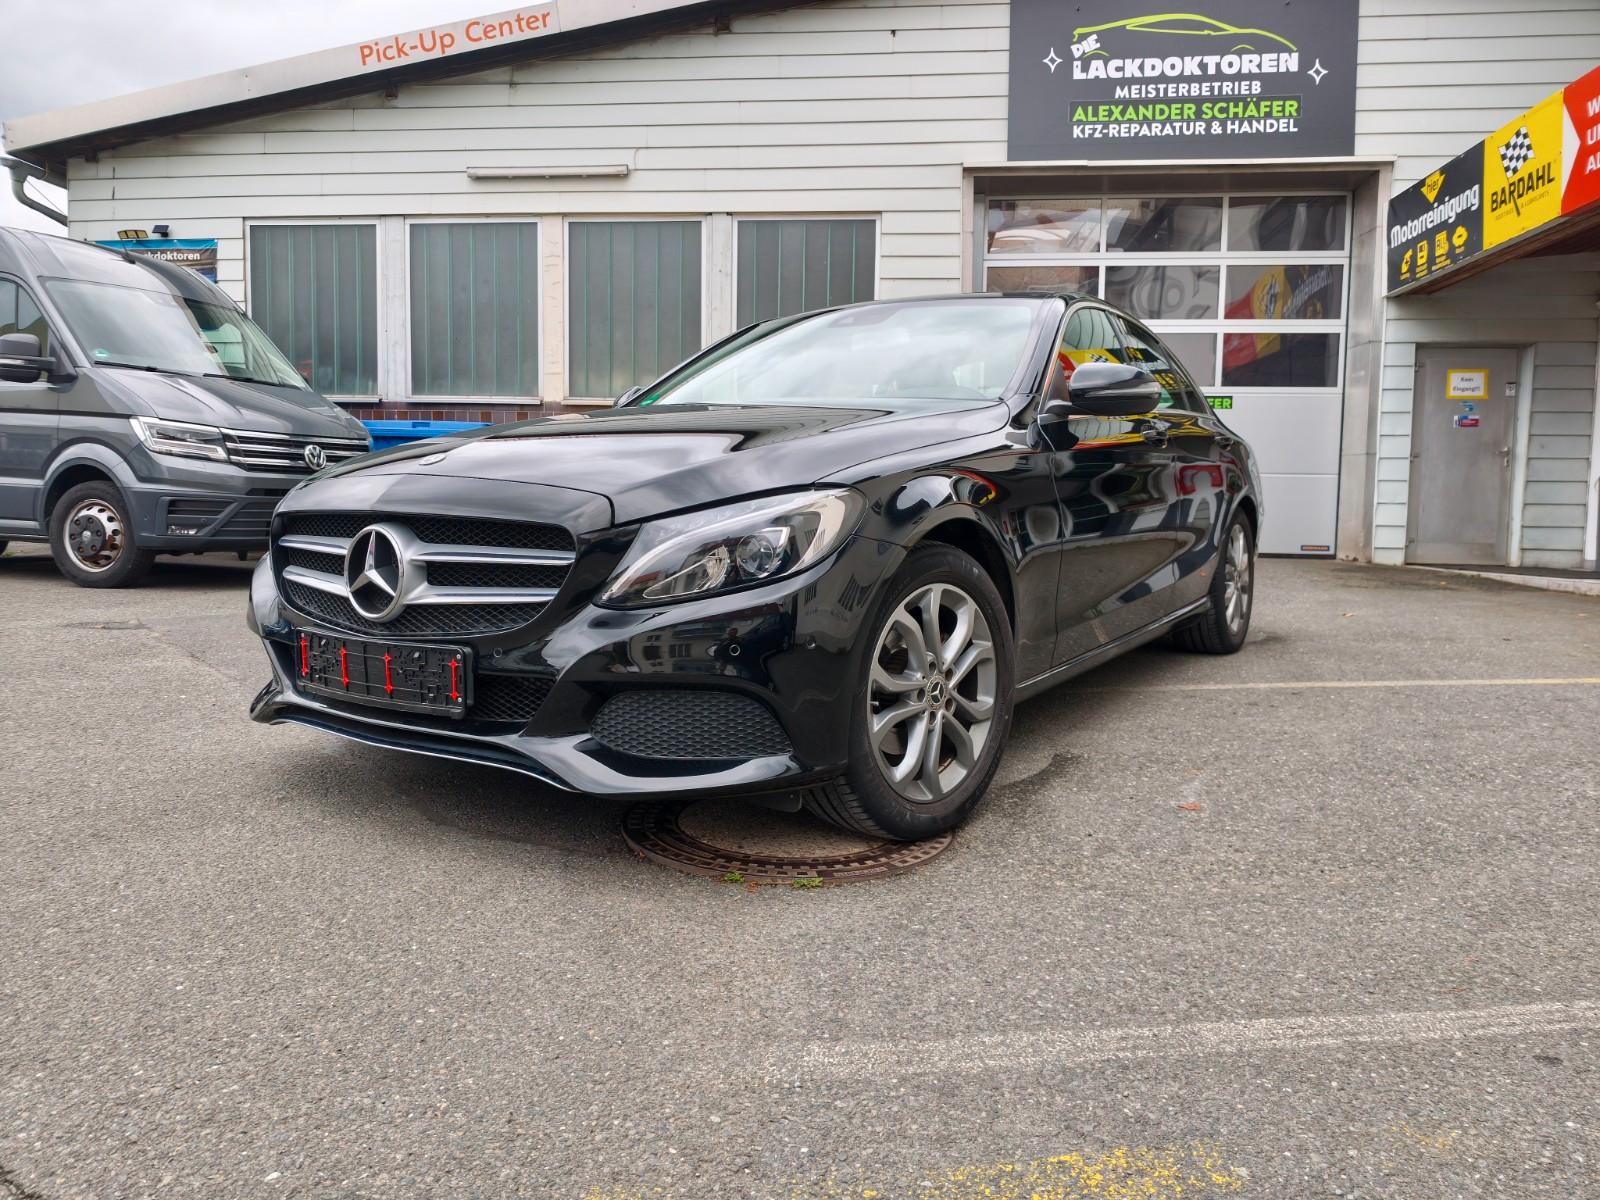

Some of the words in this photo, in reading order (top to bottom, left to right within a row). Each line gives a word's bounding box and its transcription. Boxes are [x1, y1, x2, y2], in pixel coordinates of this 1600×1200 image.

[359, 30, 455, 66] Pick-Up
[465, 11, 551, 43] Center
[1070, 33, 1101, 58] DIE
[1072, 52, 1299, 80] LACKDOKTOREN
[1114, 81, 1262, 99] MEISTERBETRIEB
[1072, 103, 1197, 122] ALEXANDER
[1201, 97, 1299, 120] SCHÄFER
[1072, 121, 1206, 139] KFZ-REPARATUR
[1210, 120, 1223, 135] &
[1226, 118, 1299, 134] HANDEL
[1426, 178, 1440, 195] hier
[1491, 162, 1555, 217] BARDAHL
[1390, 184, 1480, 248] Motorreinigung
